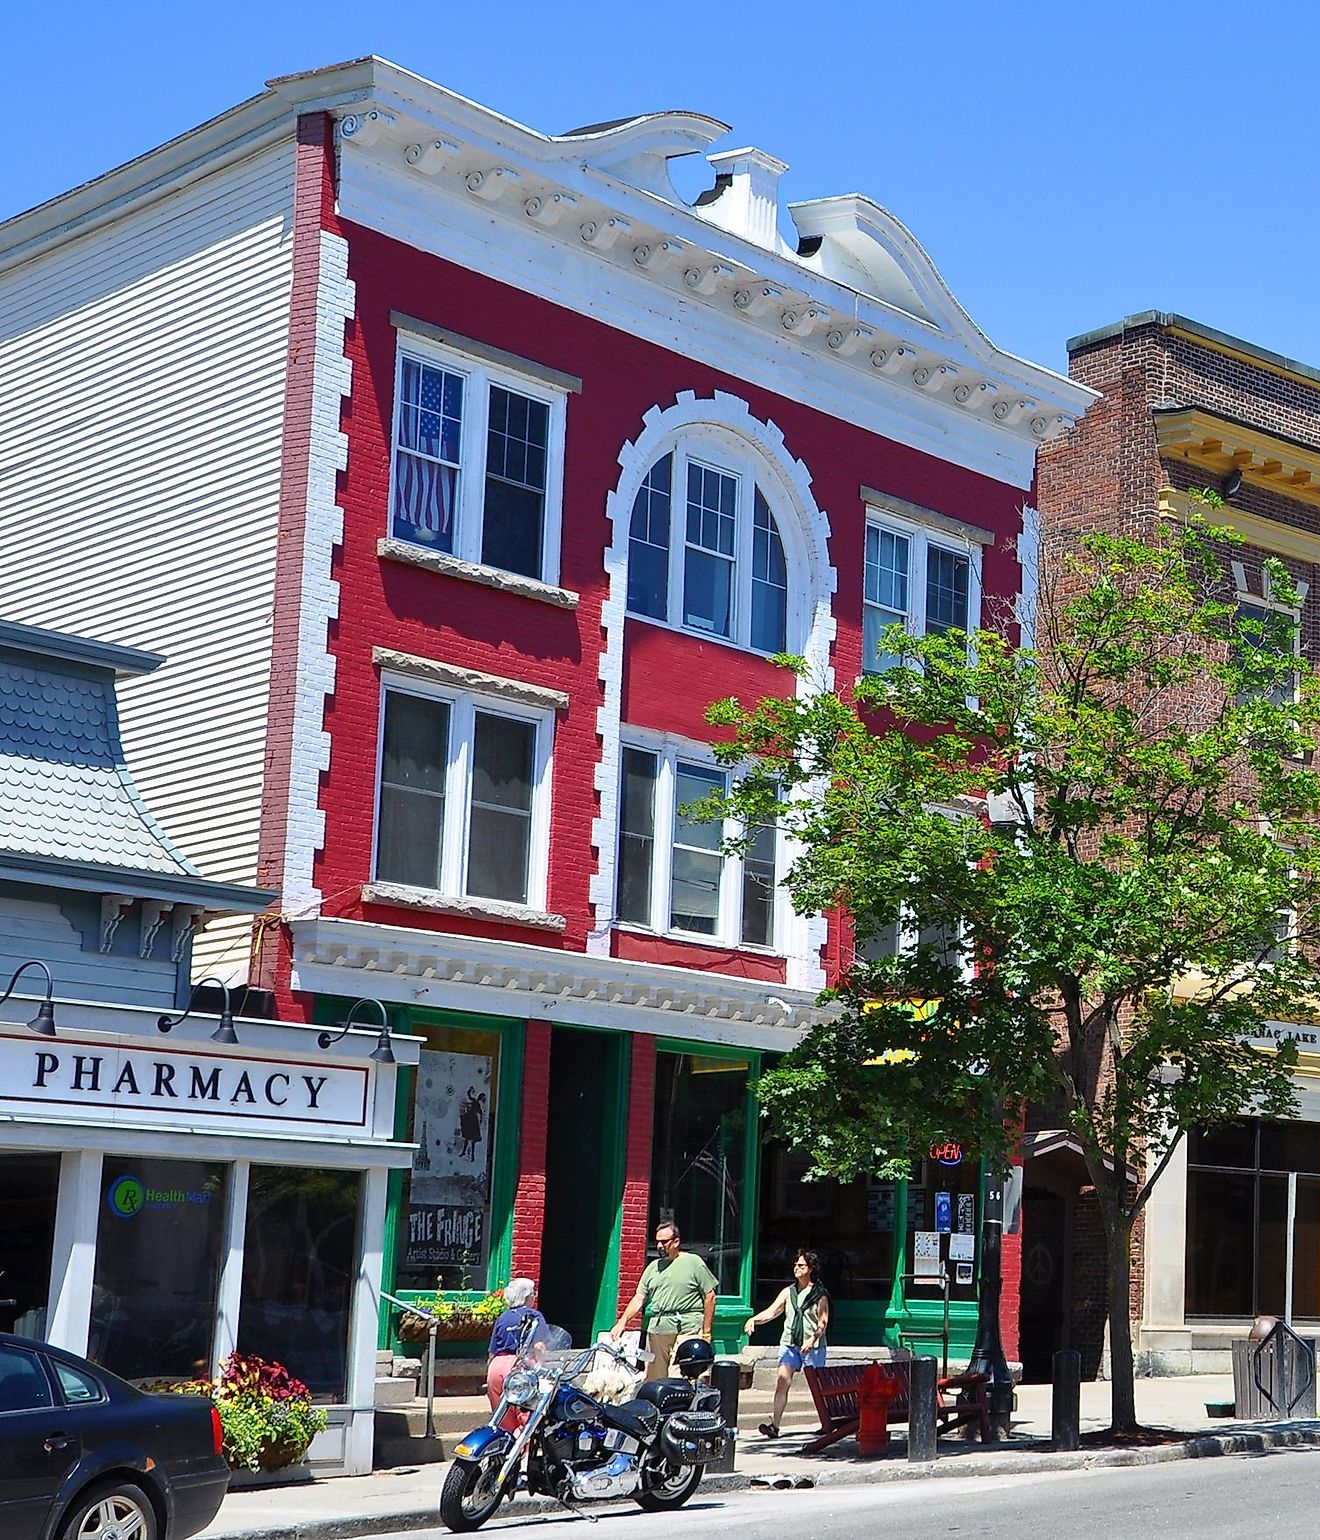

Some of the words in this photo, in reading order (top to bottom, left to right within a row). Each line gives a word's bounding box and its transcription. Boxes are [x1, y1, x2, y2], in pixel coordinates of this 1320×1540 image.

[32, 1052, 328, 1109] PHARMACY
[929, 1143, 961, 1160] OPEN
[409, 1211, 433, 1242] THE
[436, 1208, 482, 1249] FRINGE
